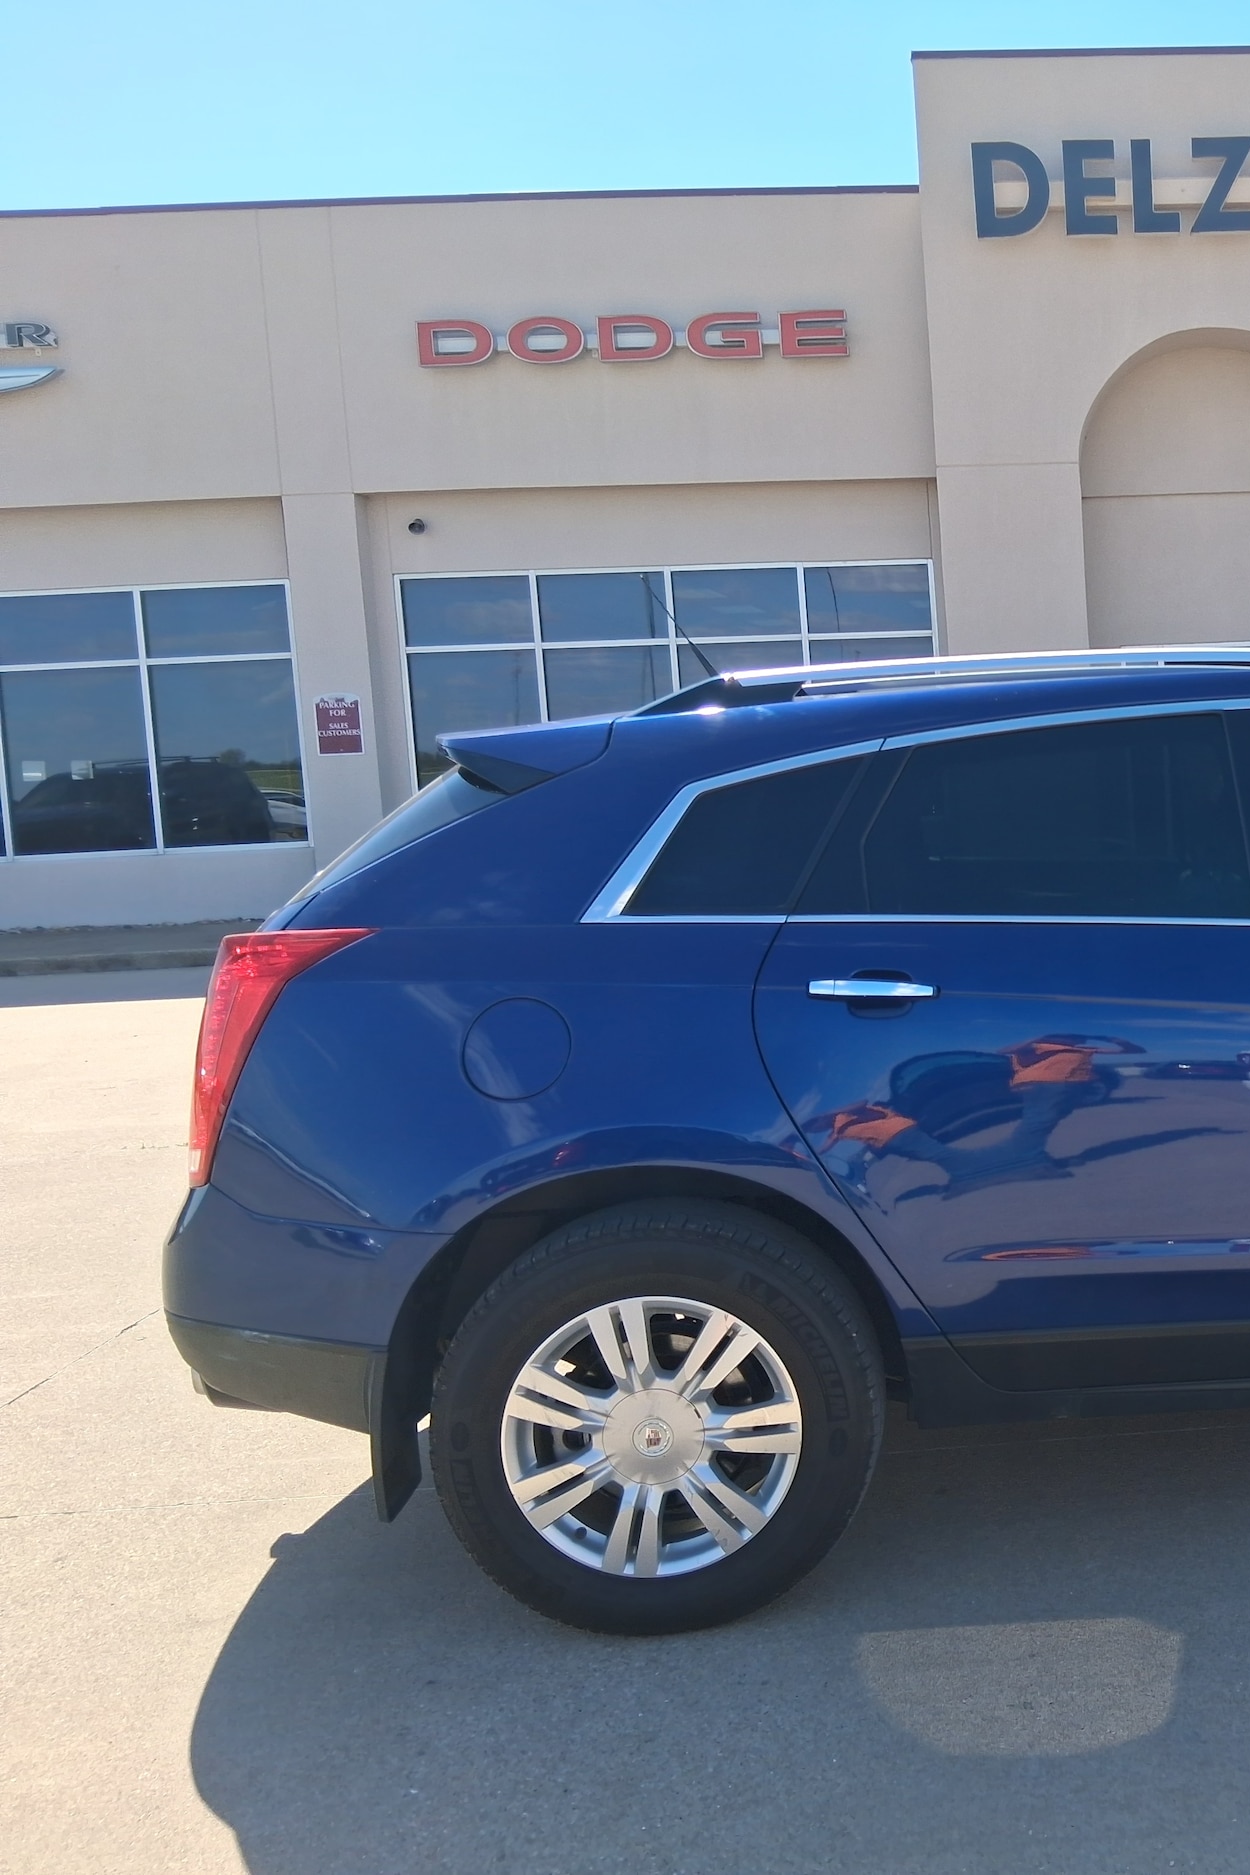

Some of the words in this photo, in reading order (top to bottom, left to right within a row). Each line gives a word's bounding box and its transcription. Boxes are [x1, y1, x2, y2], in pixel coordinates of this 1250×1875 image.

[415, 308, 851, 368] DODGE
[319, 701, 355, 709] PARKING
[329, 709, 346, 717] FOR
[318, 729, 361, 737] CUSTOMERS
[769, 1298, 850, 1421] MICHELIN
